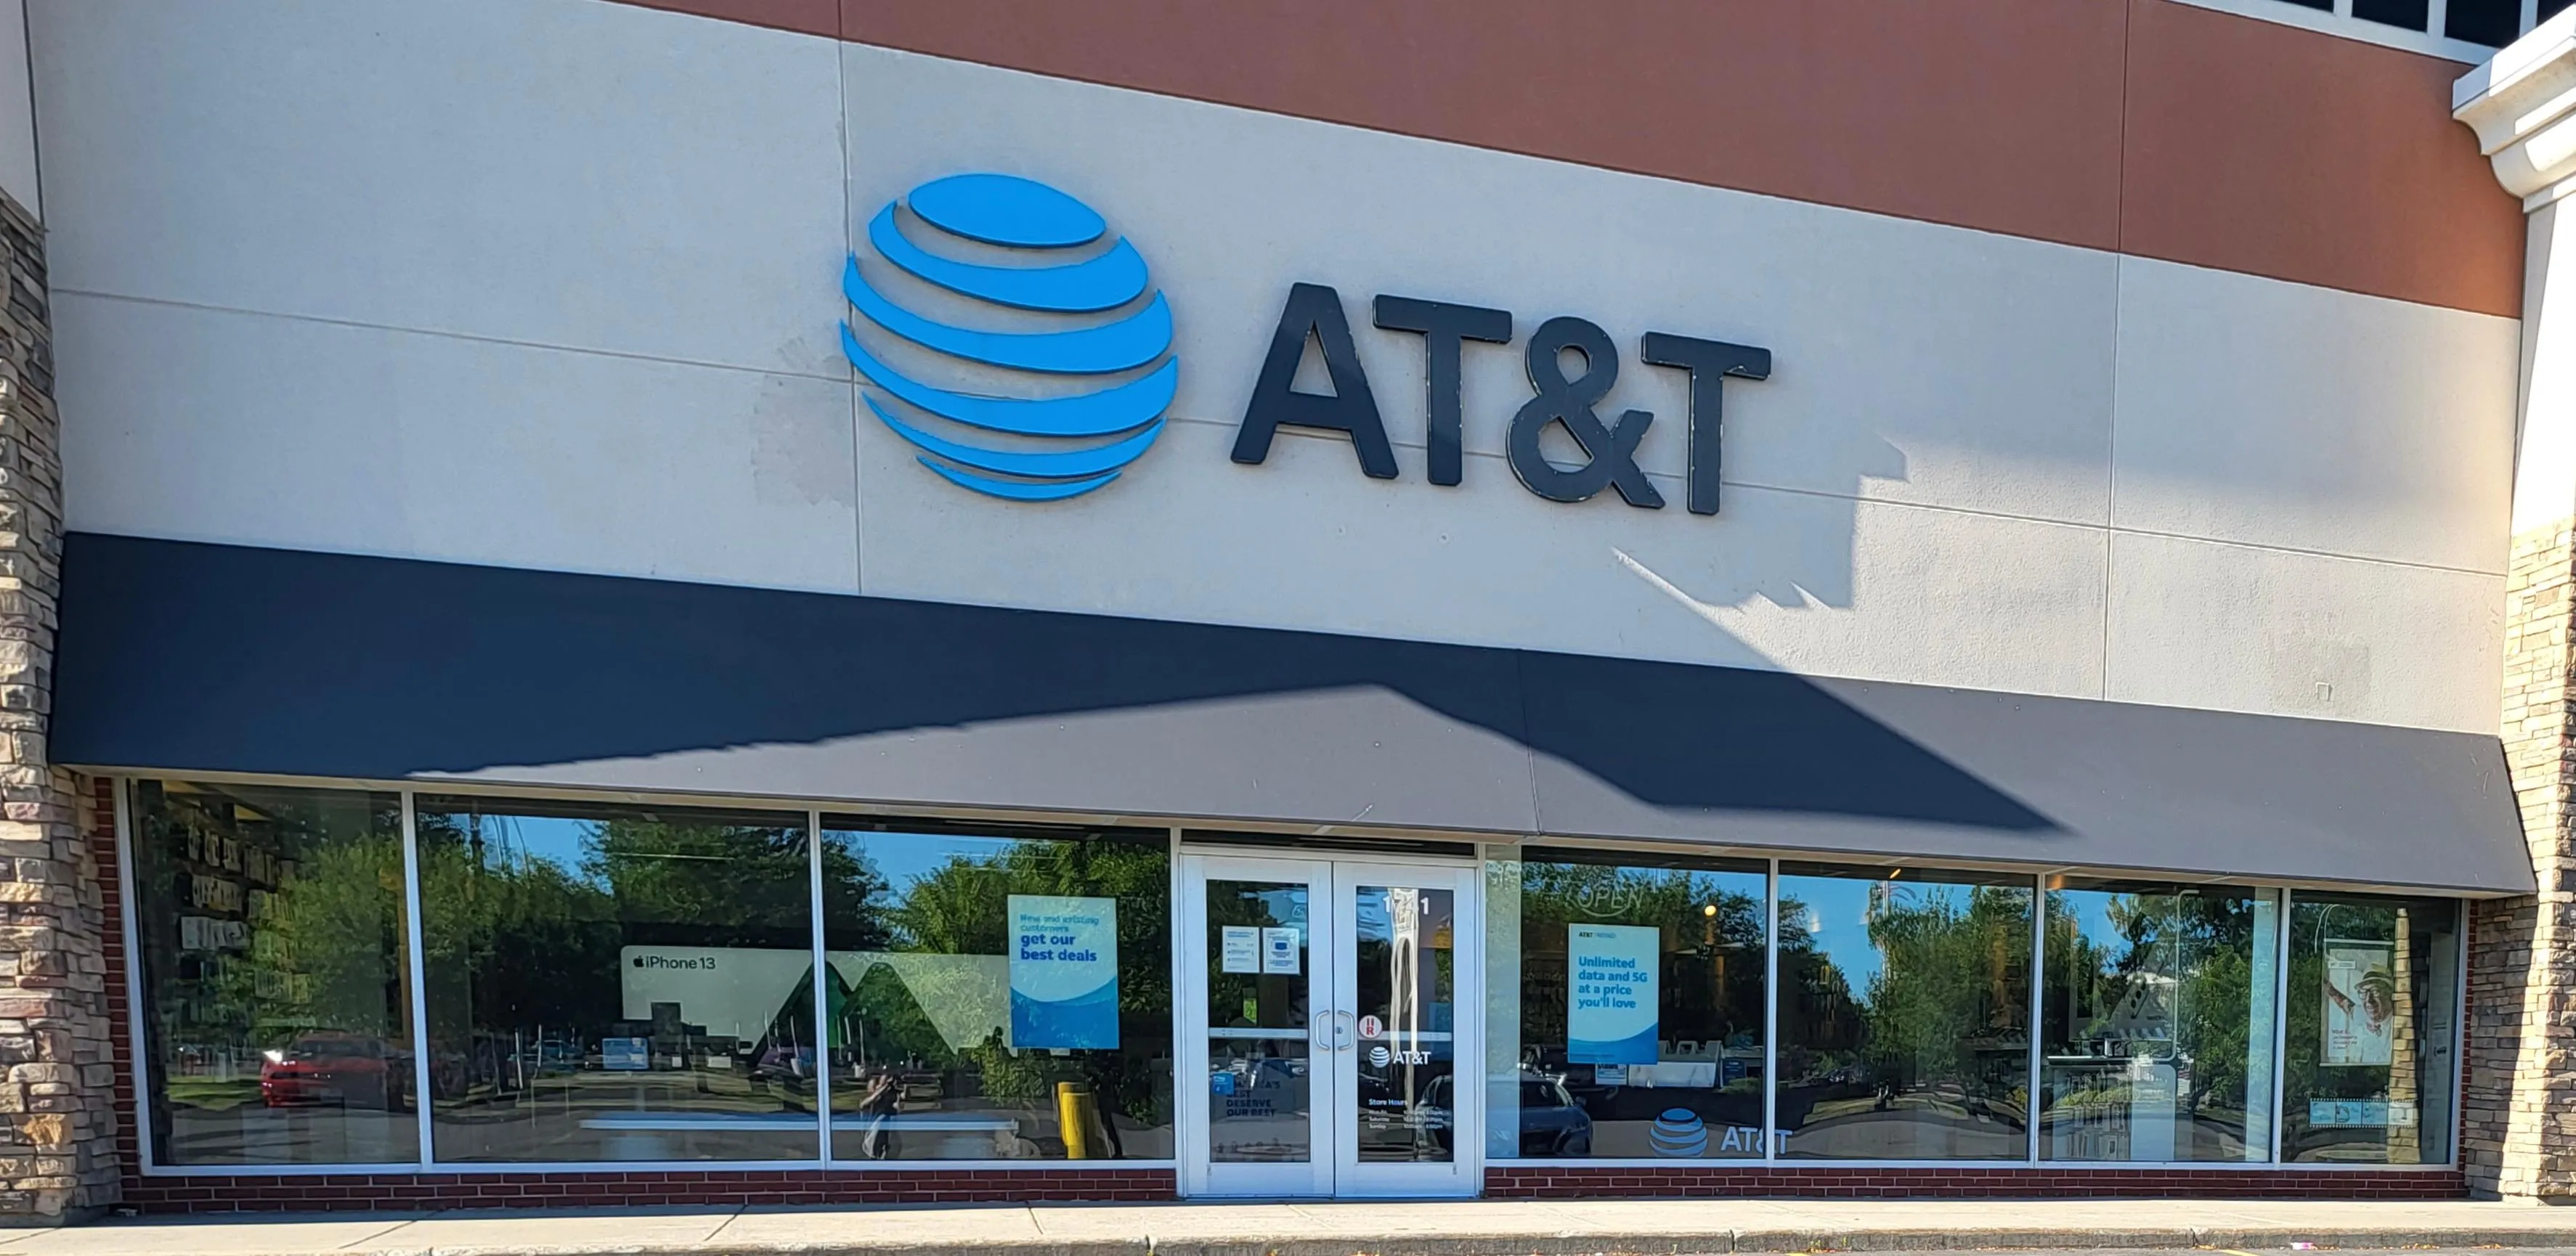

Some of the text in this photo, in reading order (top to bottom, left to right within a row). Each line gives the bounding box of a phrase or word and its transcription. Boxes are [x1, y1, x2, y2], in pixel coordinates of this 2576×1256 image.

[1230, 282, 1771, 515] AT&T
[1577, 882, 1644, 908] OPEN
[1021, 934, 1076, 947] get our
[1021, 948, 1097, 961] best deals
[646, 955, 715, 969] iPhone 13
[1579, 956, 1635, 968] Unlimited
[1579, 970, 1647, 982] data and 5G
[1579, 984, 1590, 993] at
[1604, 984, 1632, 997] price
[1578, 997, 1636, 1009] you'll love
[1393, 1051, 1431, 1065] AT&T
